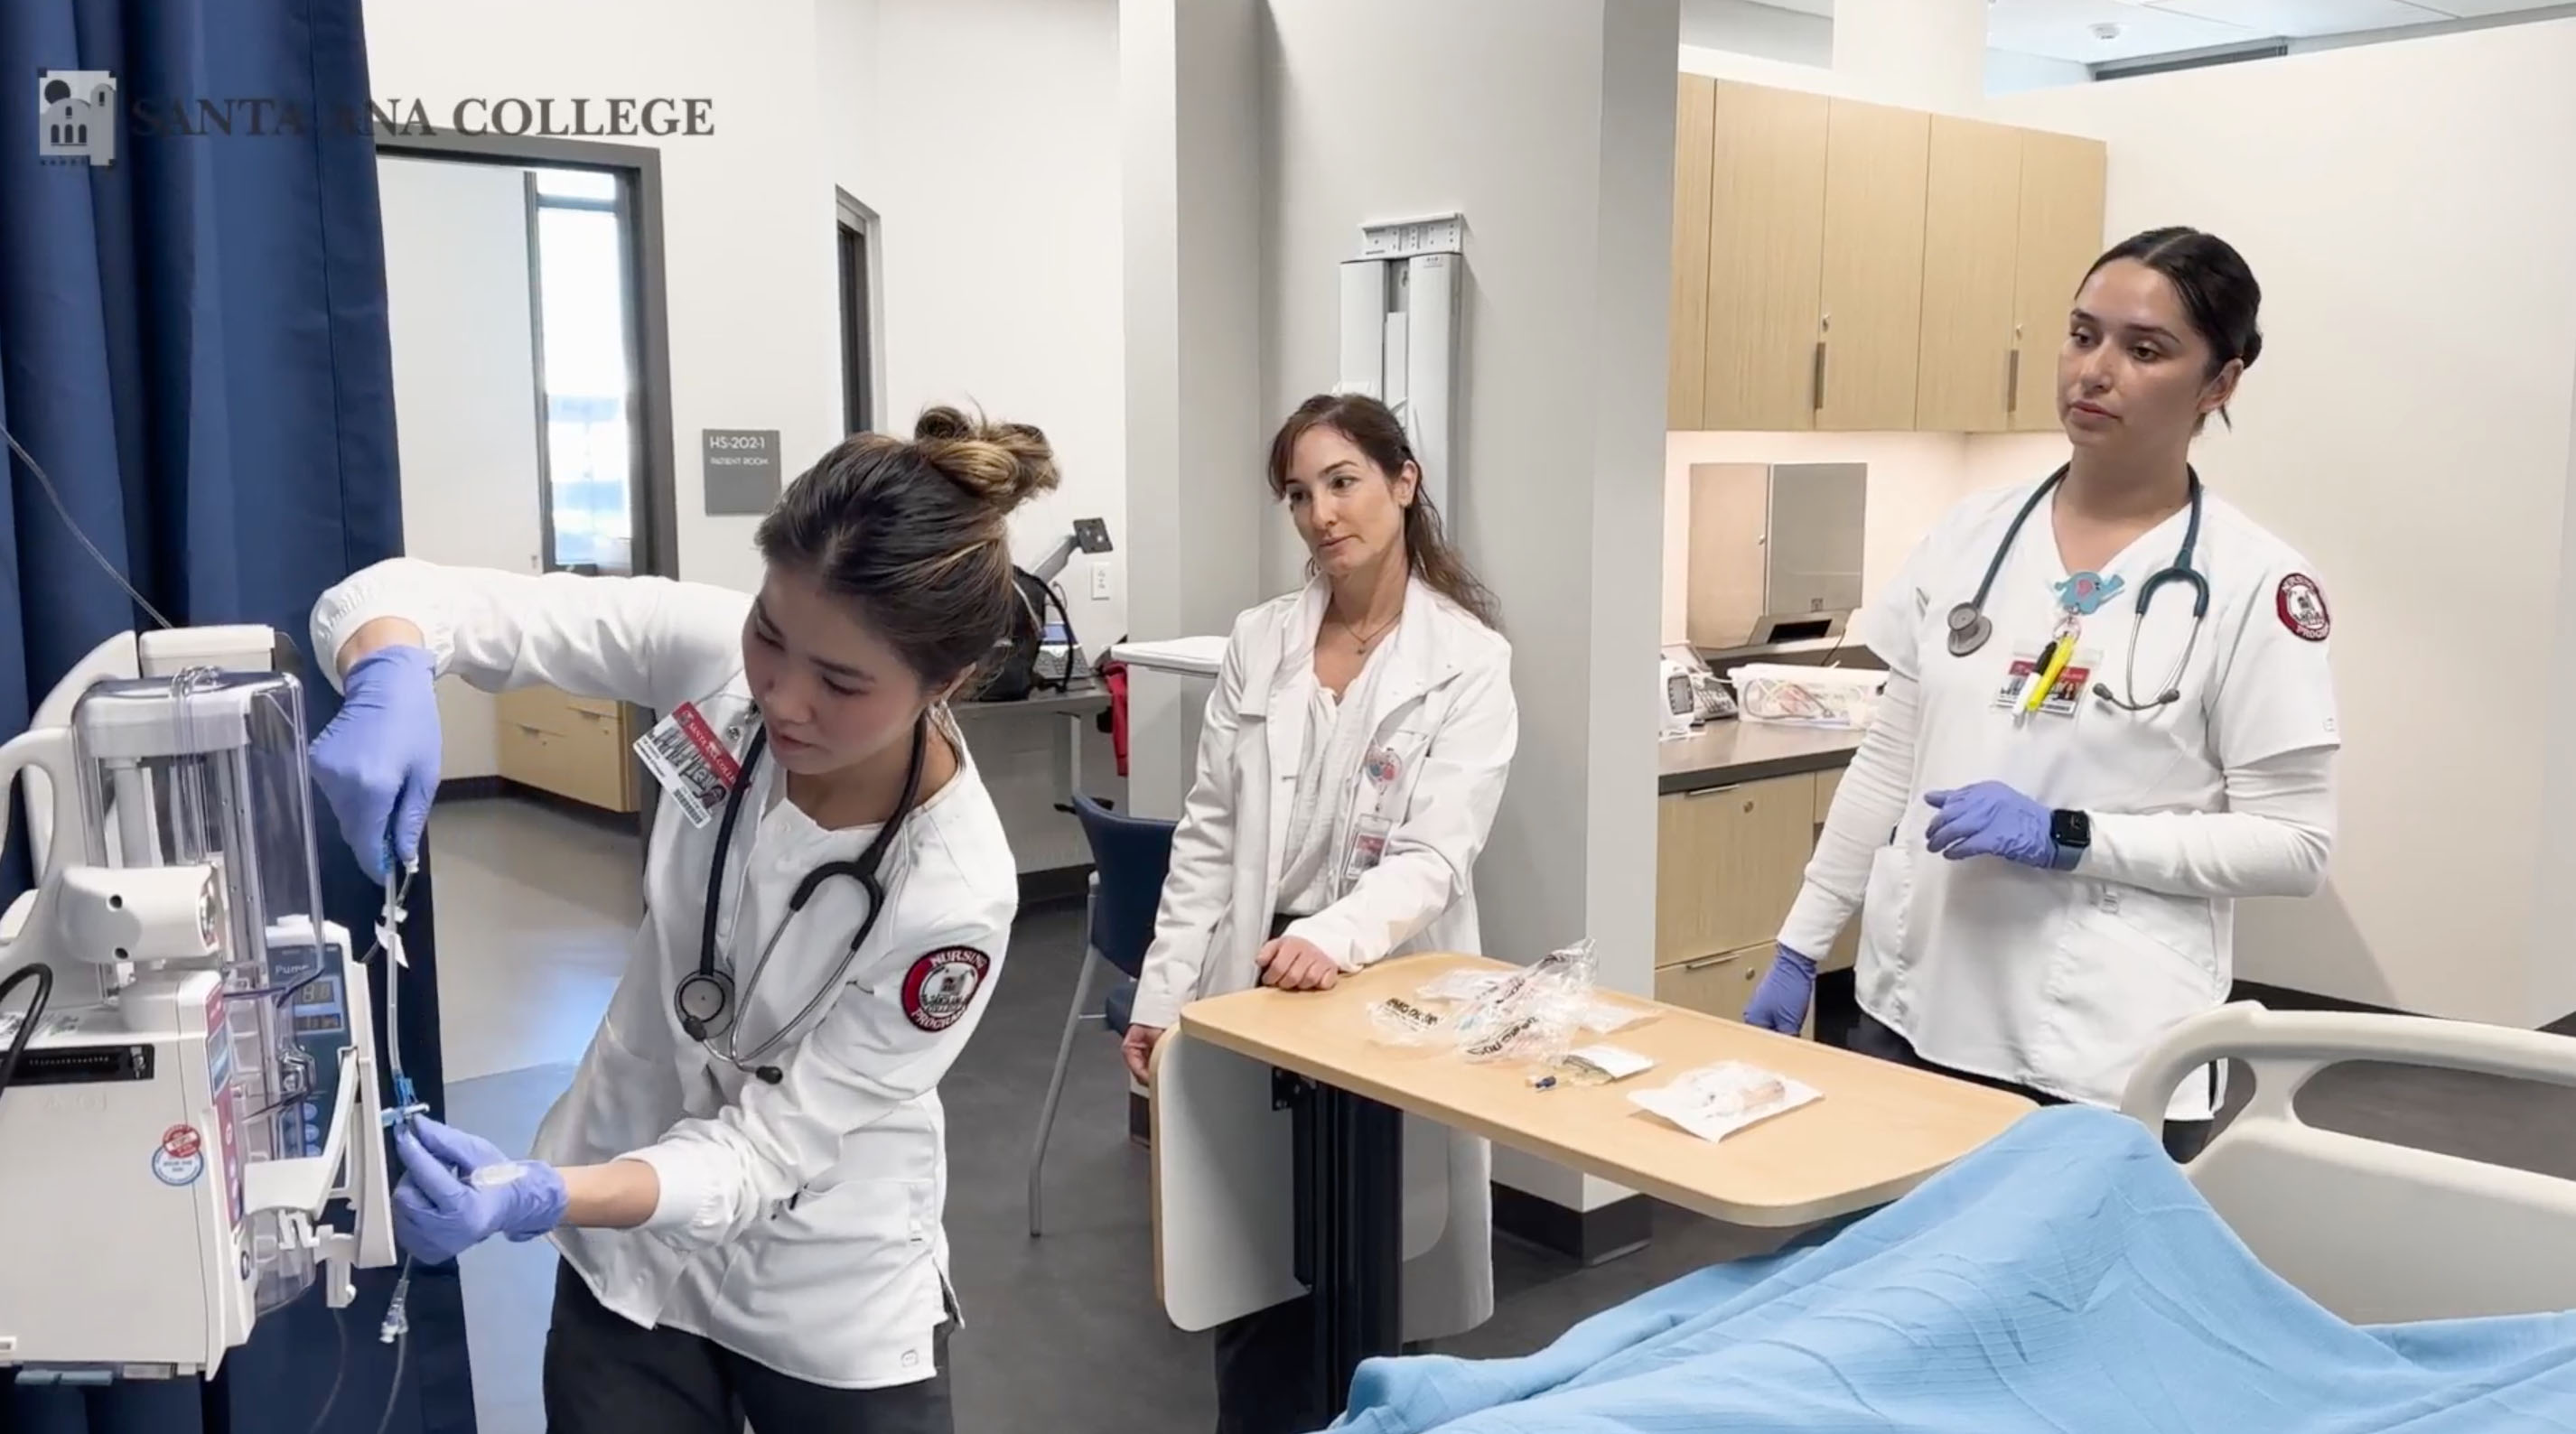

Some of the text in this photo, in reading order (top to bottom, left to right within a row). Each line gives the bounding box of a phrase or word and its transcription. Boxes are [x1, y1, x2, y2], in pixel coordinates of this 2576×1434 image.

[709, 436, 765, 449] HS-202-1
[742, 457, 770, 466] ROOM
[929, 950, 988, 970] NURSING
